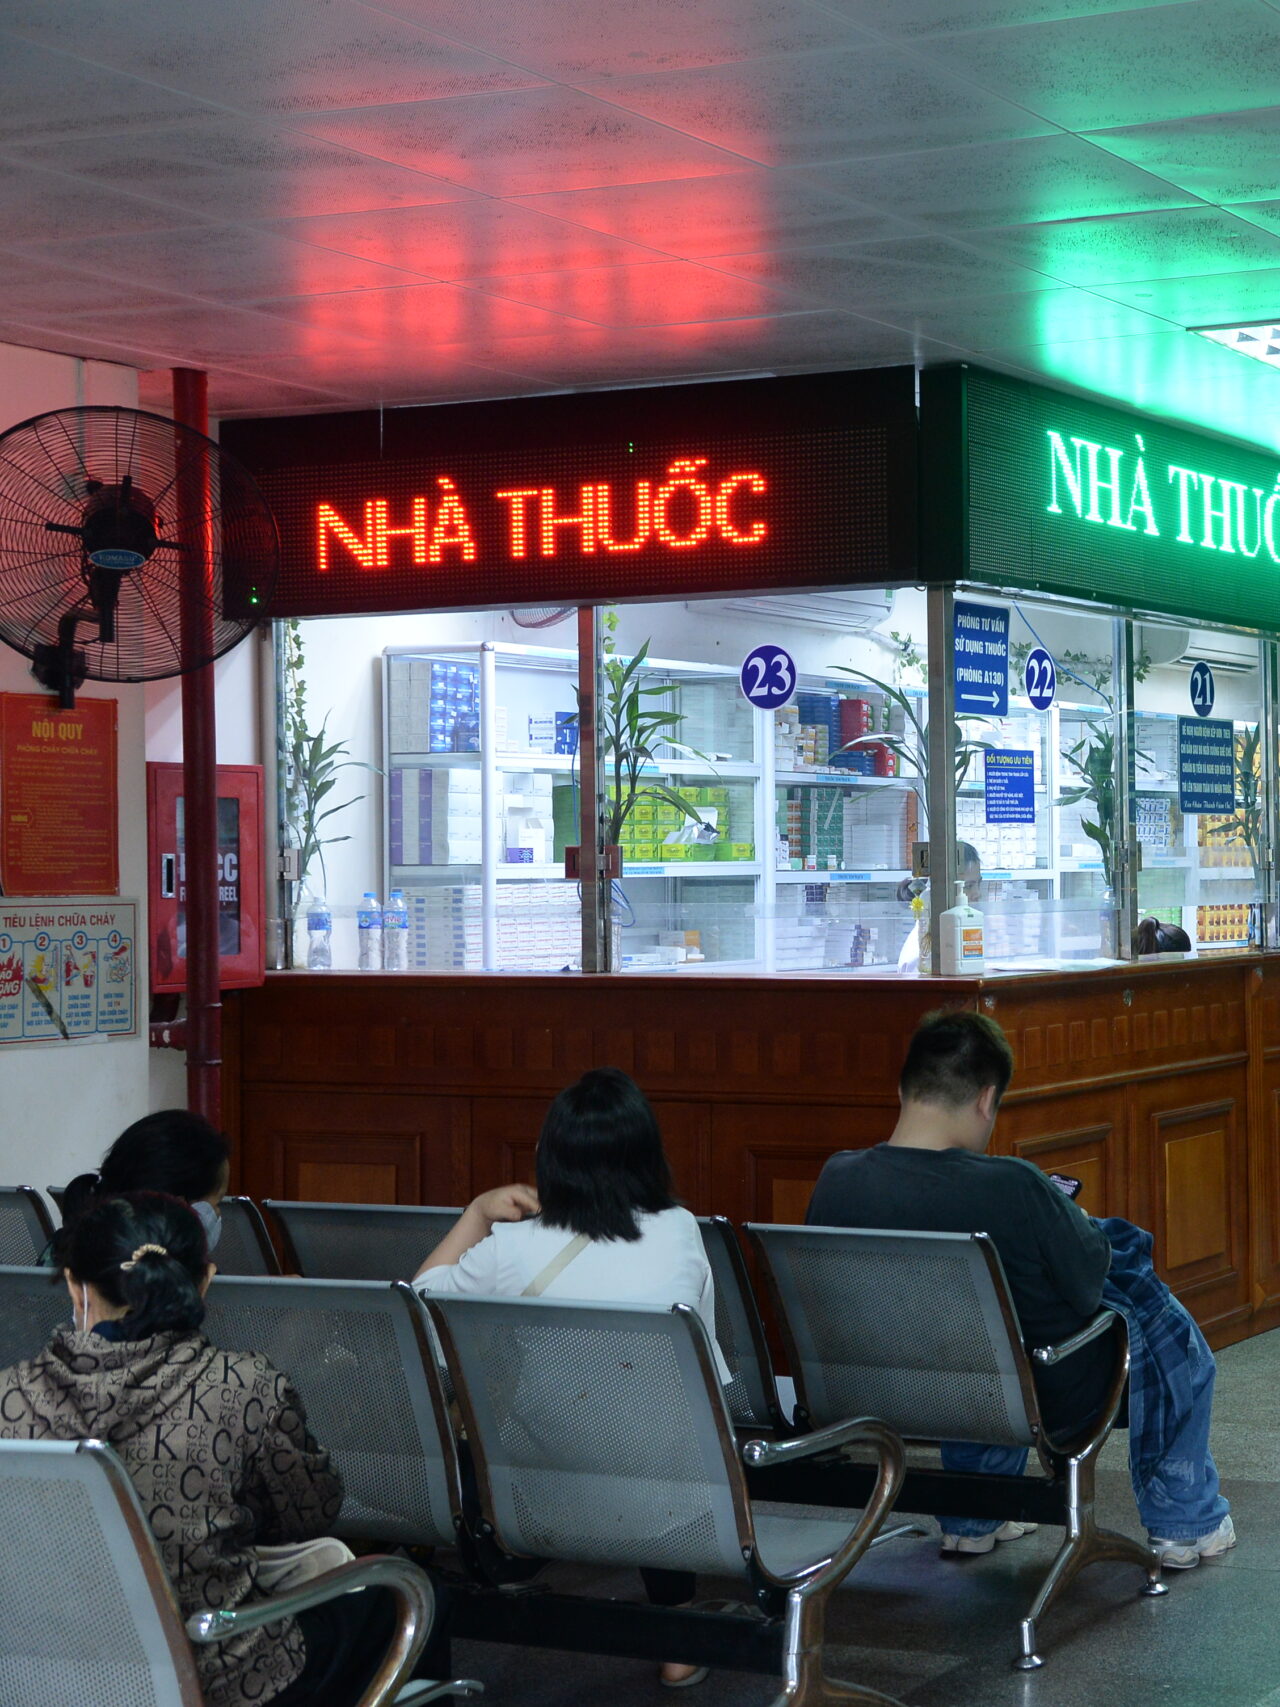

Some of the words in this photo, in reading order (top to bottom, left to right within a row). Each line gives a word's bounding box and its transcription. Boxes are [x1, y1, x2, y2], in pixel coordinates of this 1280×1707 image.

[1047, 431, 1159, 537] NHÀ
[317, 477, 476, 569] NHÀ
[496, 458, 768, 559] THUỐC
[957, 613, 980, 630] PHÒNG
[981, 618, 991, 630] TƯ
[991, 616, 1005, 633] VẤN
[955, 635, 964, 651] SỬ
[965, 641, 983, 656] DỤNG
[985, 640, 1006, 657] THUỐC
[748, 654, 791, 697] 23
[957, 665, 983, 683] (PHÒNG
[984, 671, 1004, 687] A130)
[1028, 659, 1053, 697] 22
[1193, 670, 1212, 705] 21
[32, 718, 54, 741] NỘI
[58, 722, 83, 741] QUY
[3, 914, 26, 928] TIÊU
[29, 913, 55, 930] LỆNH
[57, 912, 87, 926] CHỮA
[89, 911, 116, 926] CHÁY
[2, 938, 6, 948] 1
[39, 936, 46, 947] 2
[76, 934, 84, 946] 3
[111, 934, 118, 944] 4
[1, 1388, 26, 1422] C
[187, 1384, 214, 1424] K
[221, 1388, 243, 1405] CK
[218, 1412, 239, 1427] KC
[243, 1399, 264, 1435] C
[152, 1424, 182, 1460] K
[187, 1424, 207, 1440] CK
[186, 1450, 207, 1463] KC
[212, 1428, 232, 1466] C
[152, 1464, 176, 1480] CK
[179, 1465, 205, 1501] C
[152, 1487, 175, 1501] KC
[148, 1504, 175, 1541] C
[179, 1505, 199, 1519] CK
[181, 1528, 203, 1541] KC
[178, 1544, 202, 1577] K
[203, 1574, 224, 1607] C
